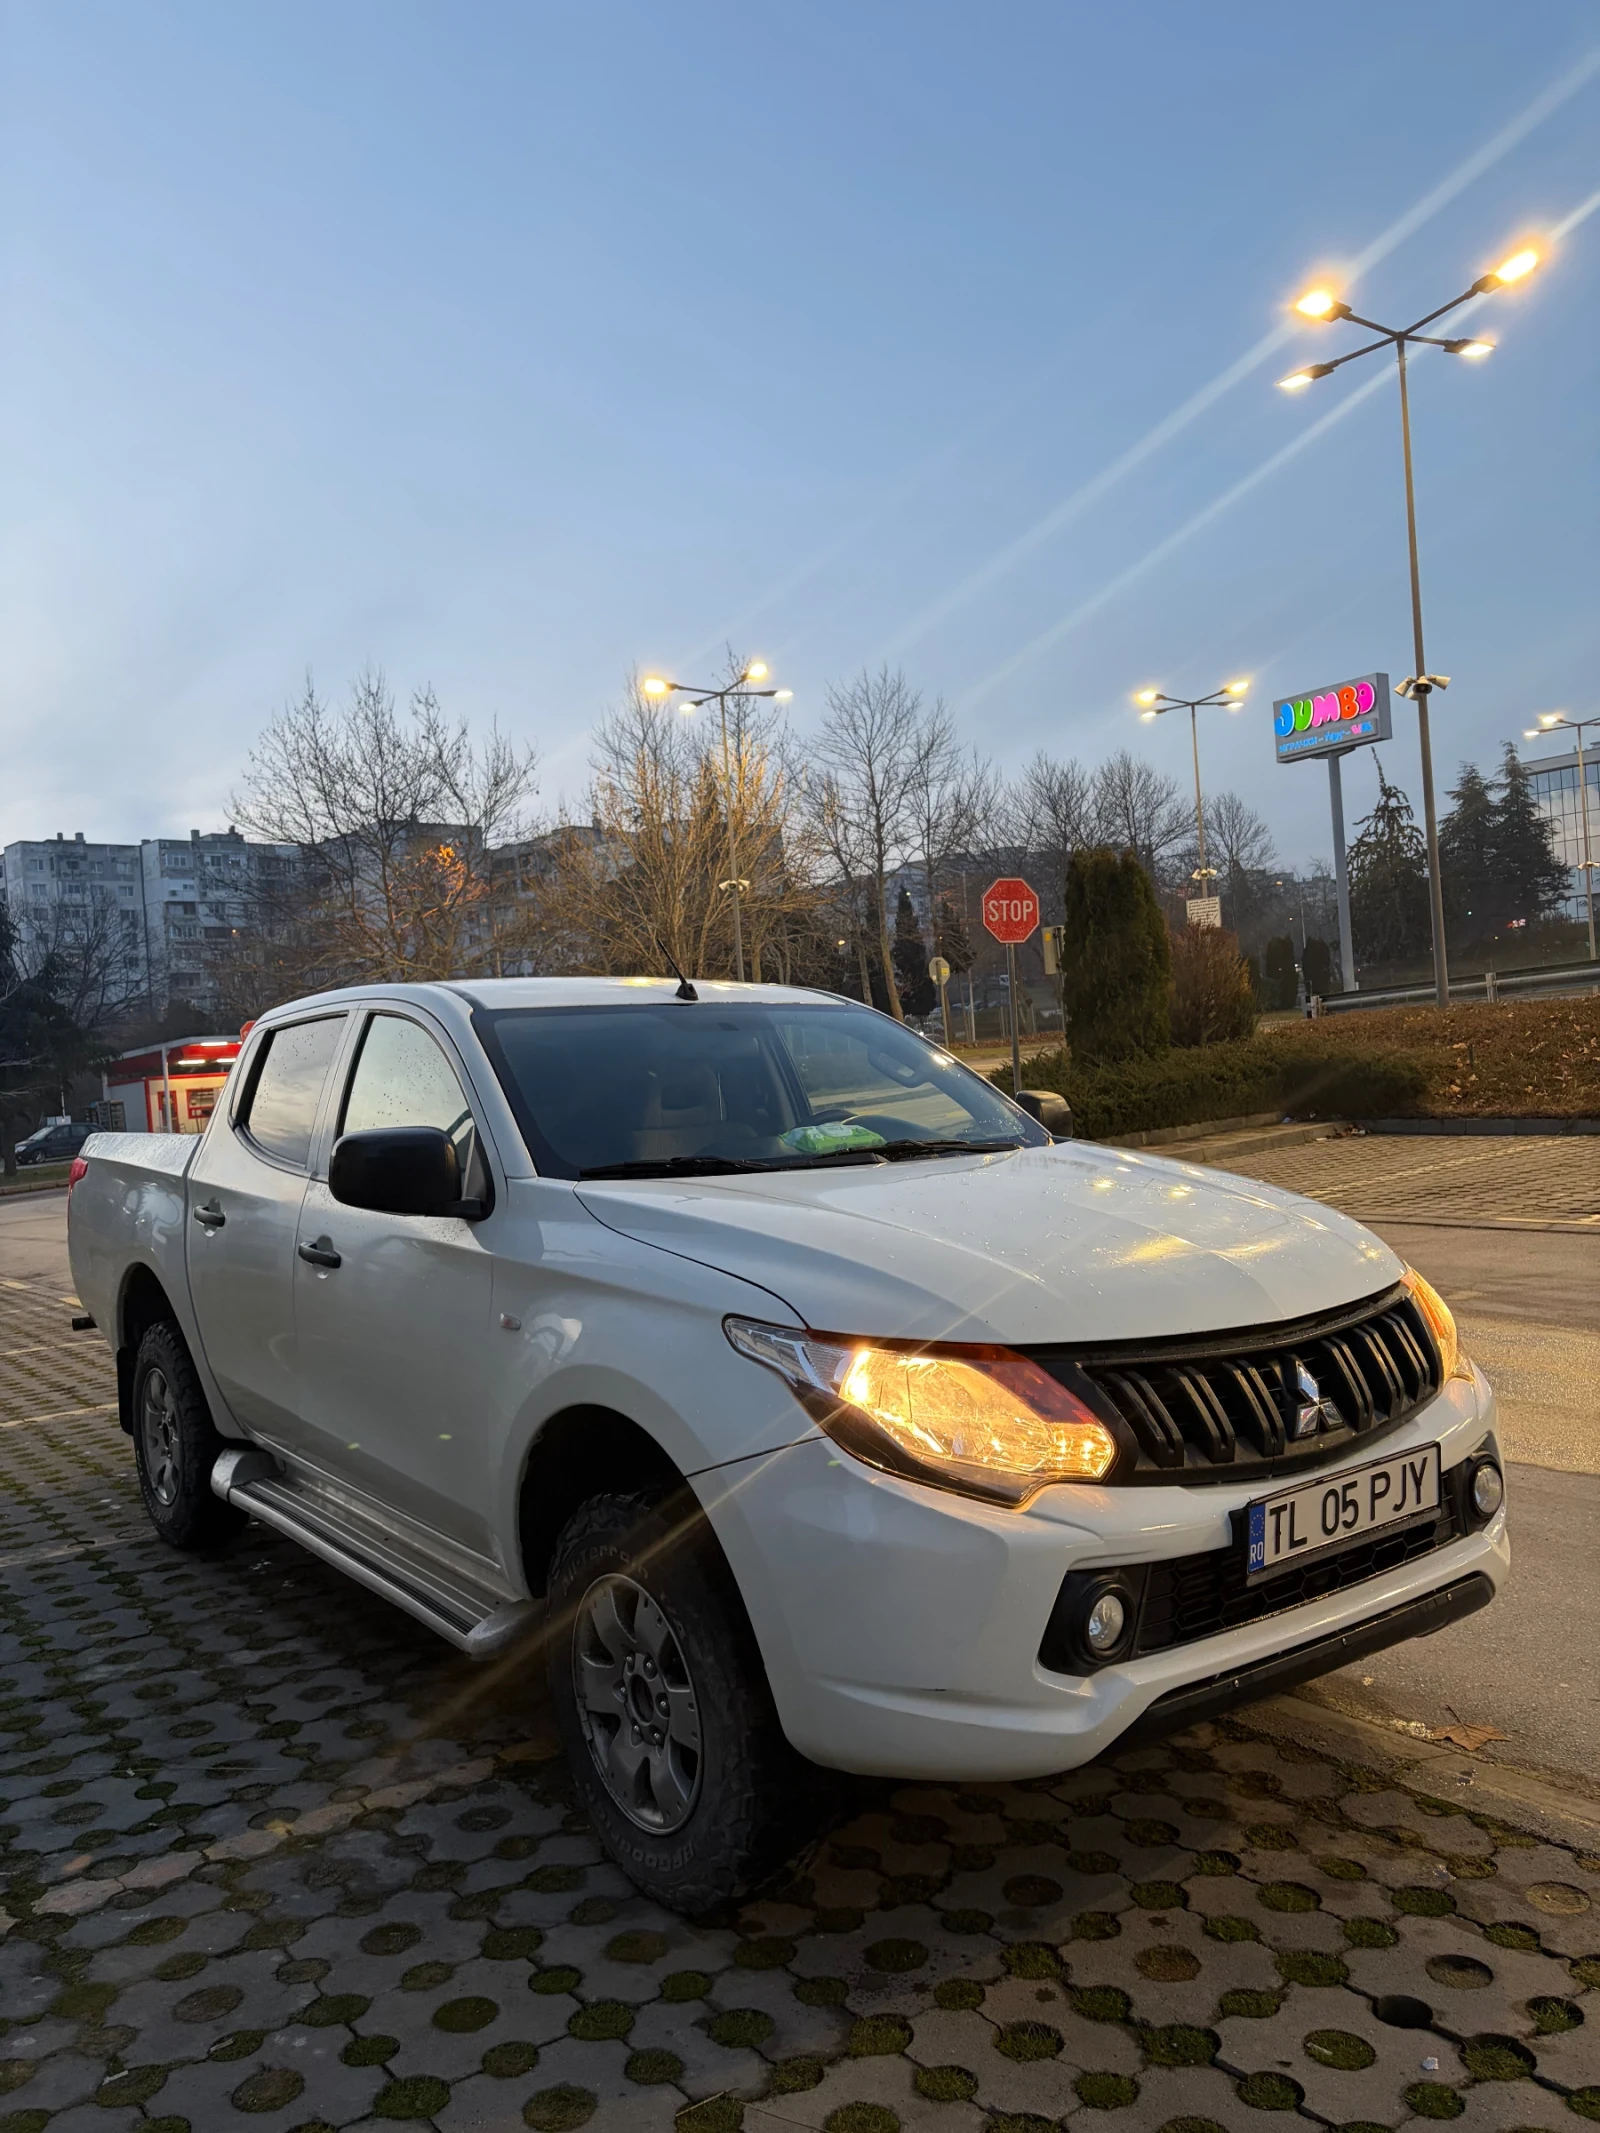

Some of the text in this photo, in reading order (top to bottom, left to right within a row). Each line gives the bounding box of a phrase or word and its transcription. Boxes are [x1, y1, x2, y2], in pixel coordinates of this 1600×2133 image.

[1274, 681, 1375, 737] JUMBO
[988, 899, 1034, 922] STOP
[1269, 1456, 1429, 1555] TL 05 PJY
[1249, 1540, 1264, 1565] RO
